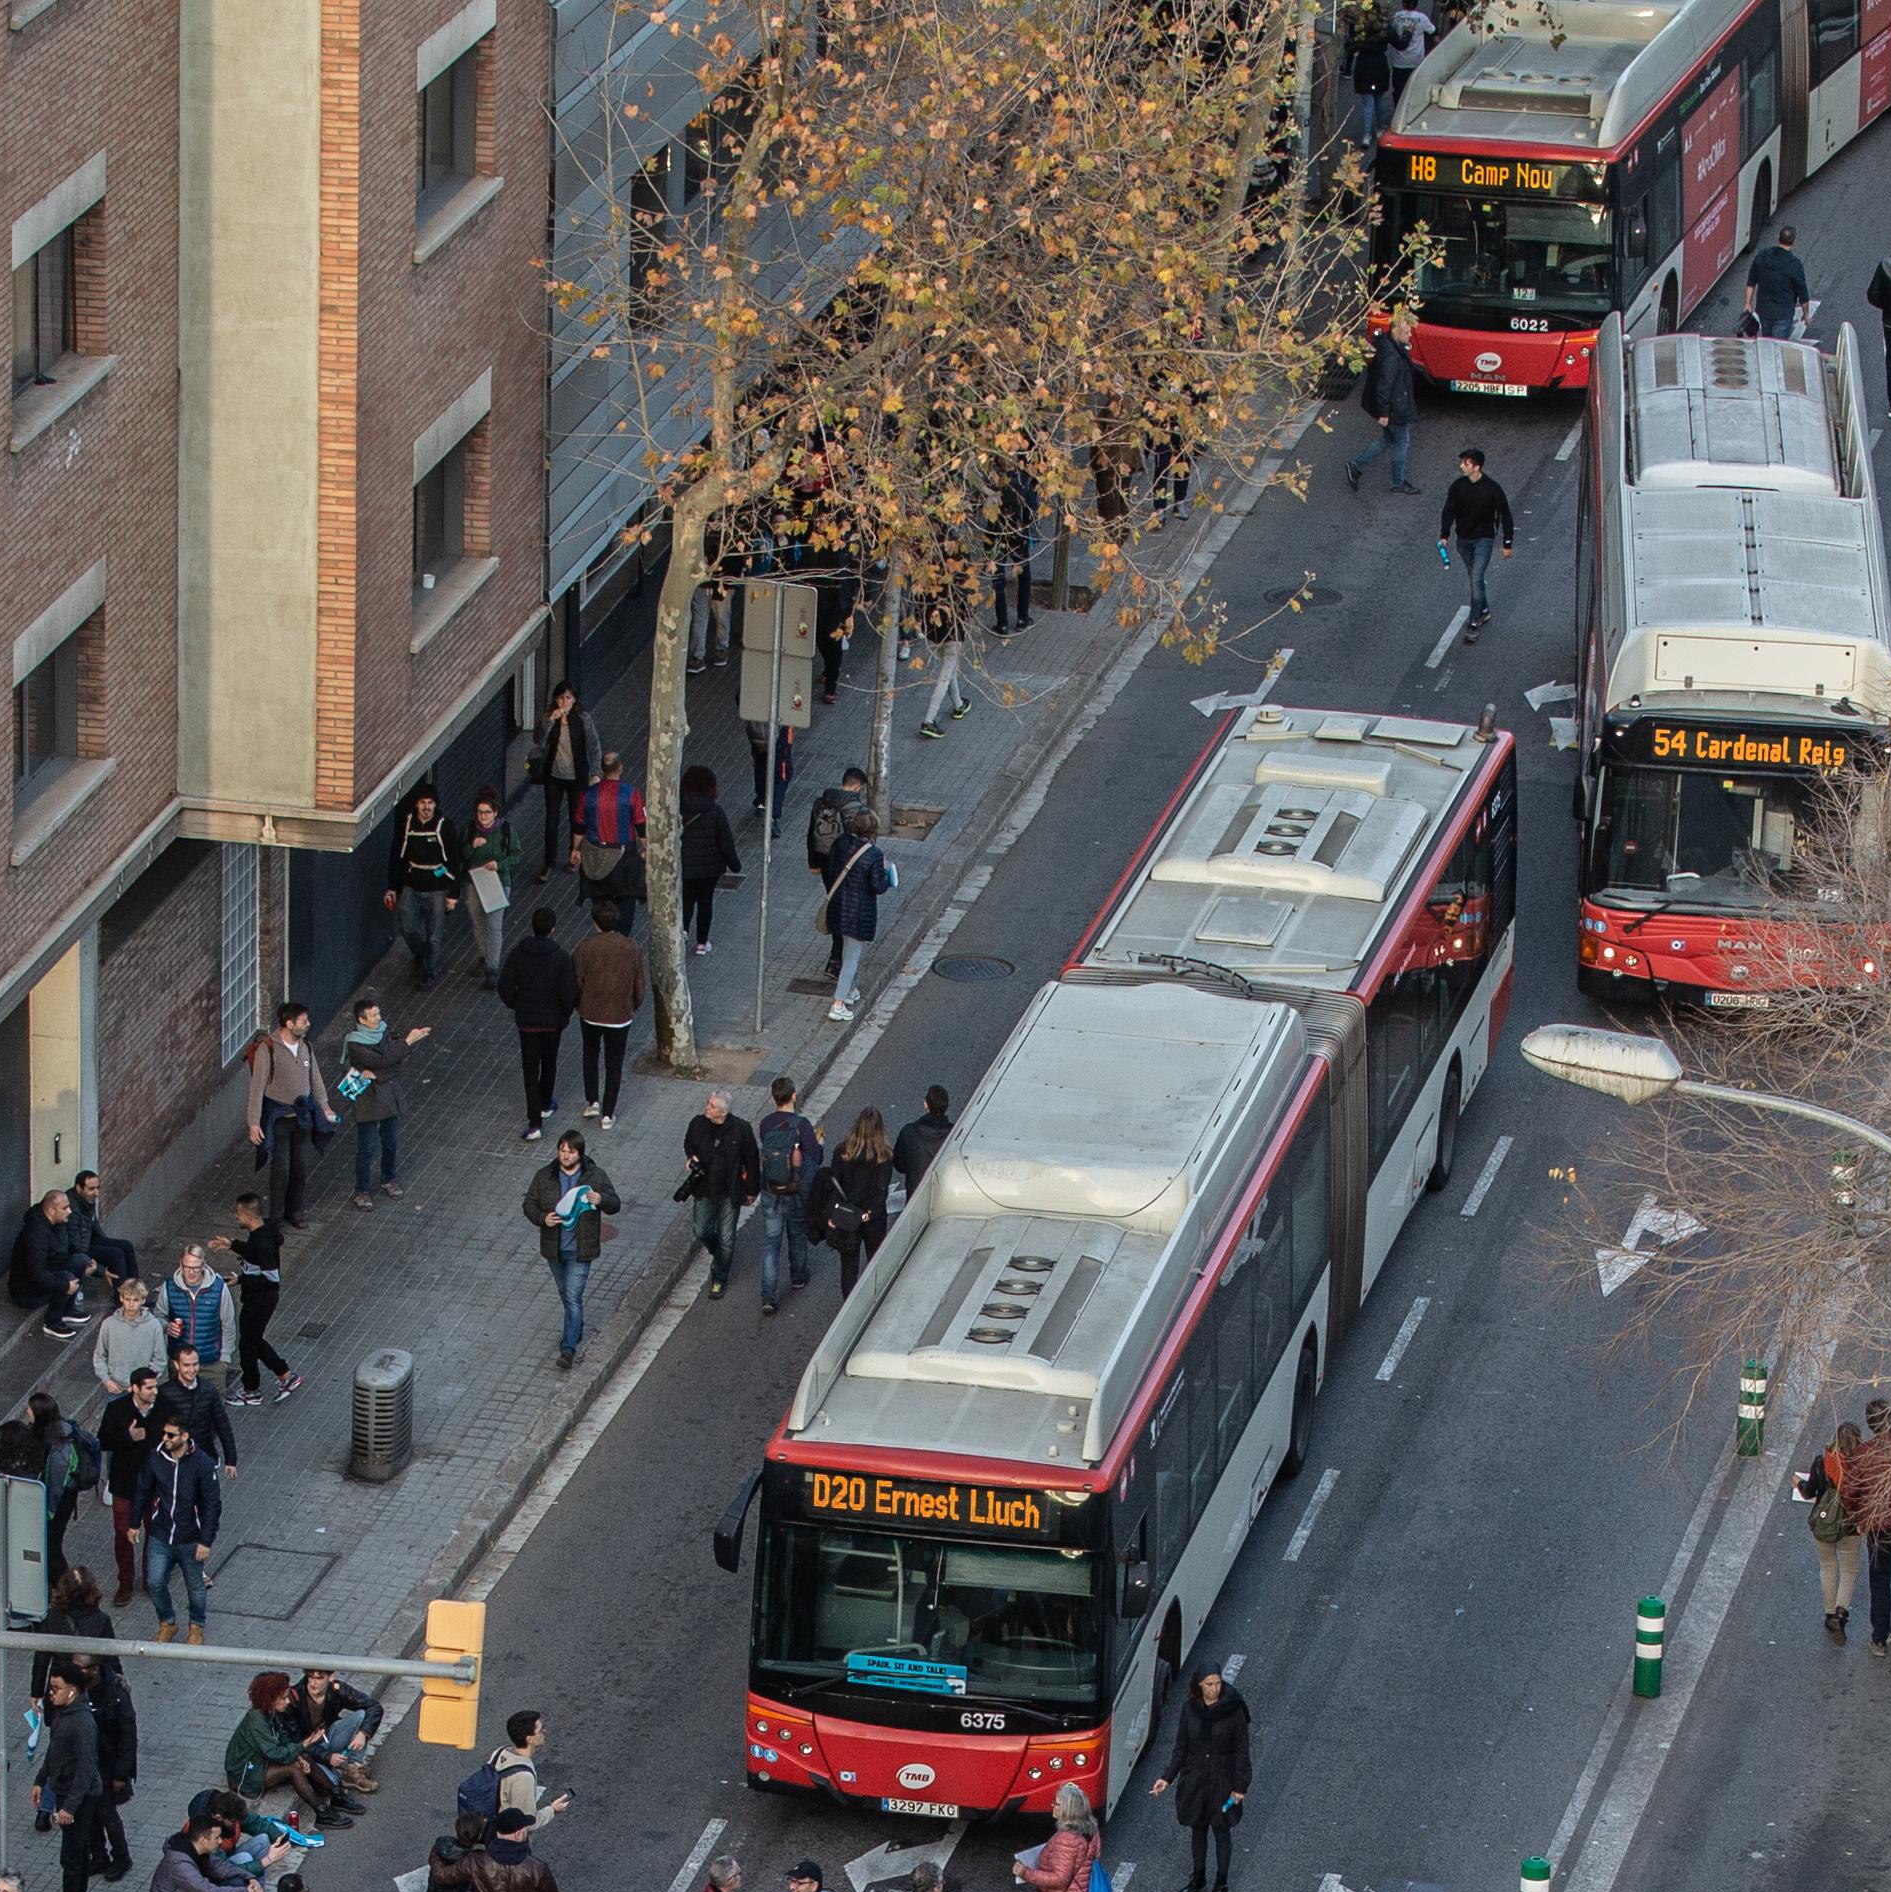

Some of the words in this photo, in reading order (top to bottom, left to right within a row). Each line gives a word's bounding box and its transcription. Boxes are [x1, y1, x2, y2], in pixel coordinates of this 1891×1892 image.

[1411, 155, 1437, 181] H8
[1461, 158, 1509, 187] Camp
[1516, 163, 1553, 191] Nou
[1510, 317, 1549, 332] 6022
[1470, 371, 1507, 382] MAN
[1458, 381, 1481, 392] 2205
[1653, 729, 1687, 758] 54
[1695, 732, 1790, 764] Cardenal
[1797, 737, 1846, 768] Reig
[1717, 938, 1763, 951] MAN
[812, 1473, 866, 1512] D20
[875, 1480, 960, 1521] Ernest
[969, 1489, 1040, 1530] Lluch
[959, 1712, 1006, 1731] 6375
[903, 1771, 931, 1783] TMB
[888, 1799, 924, 1814] 3297
